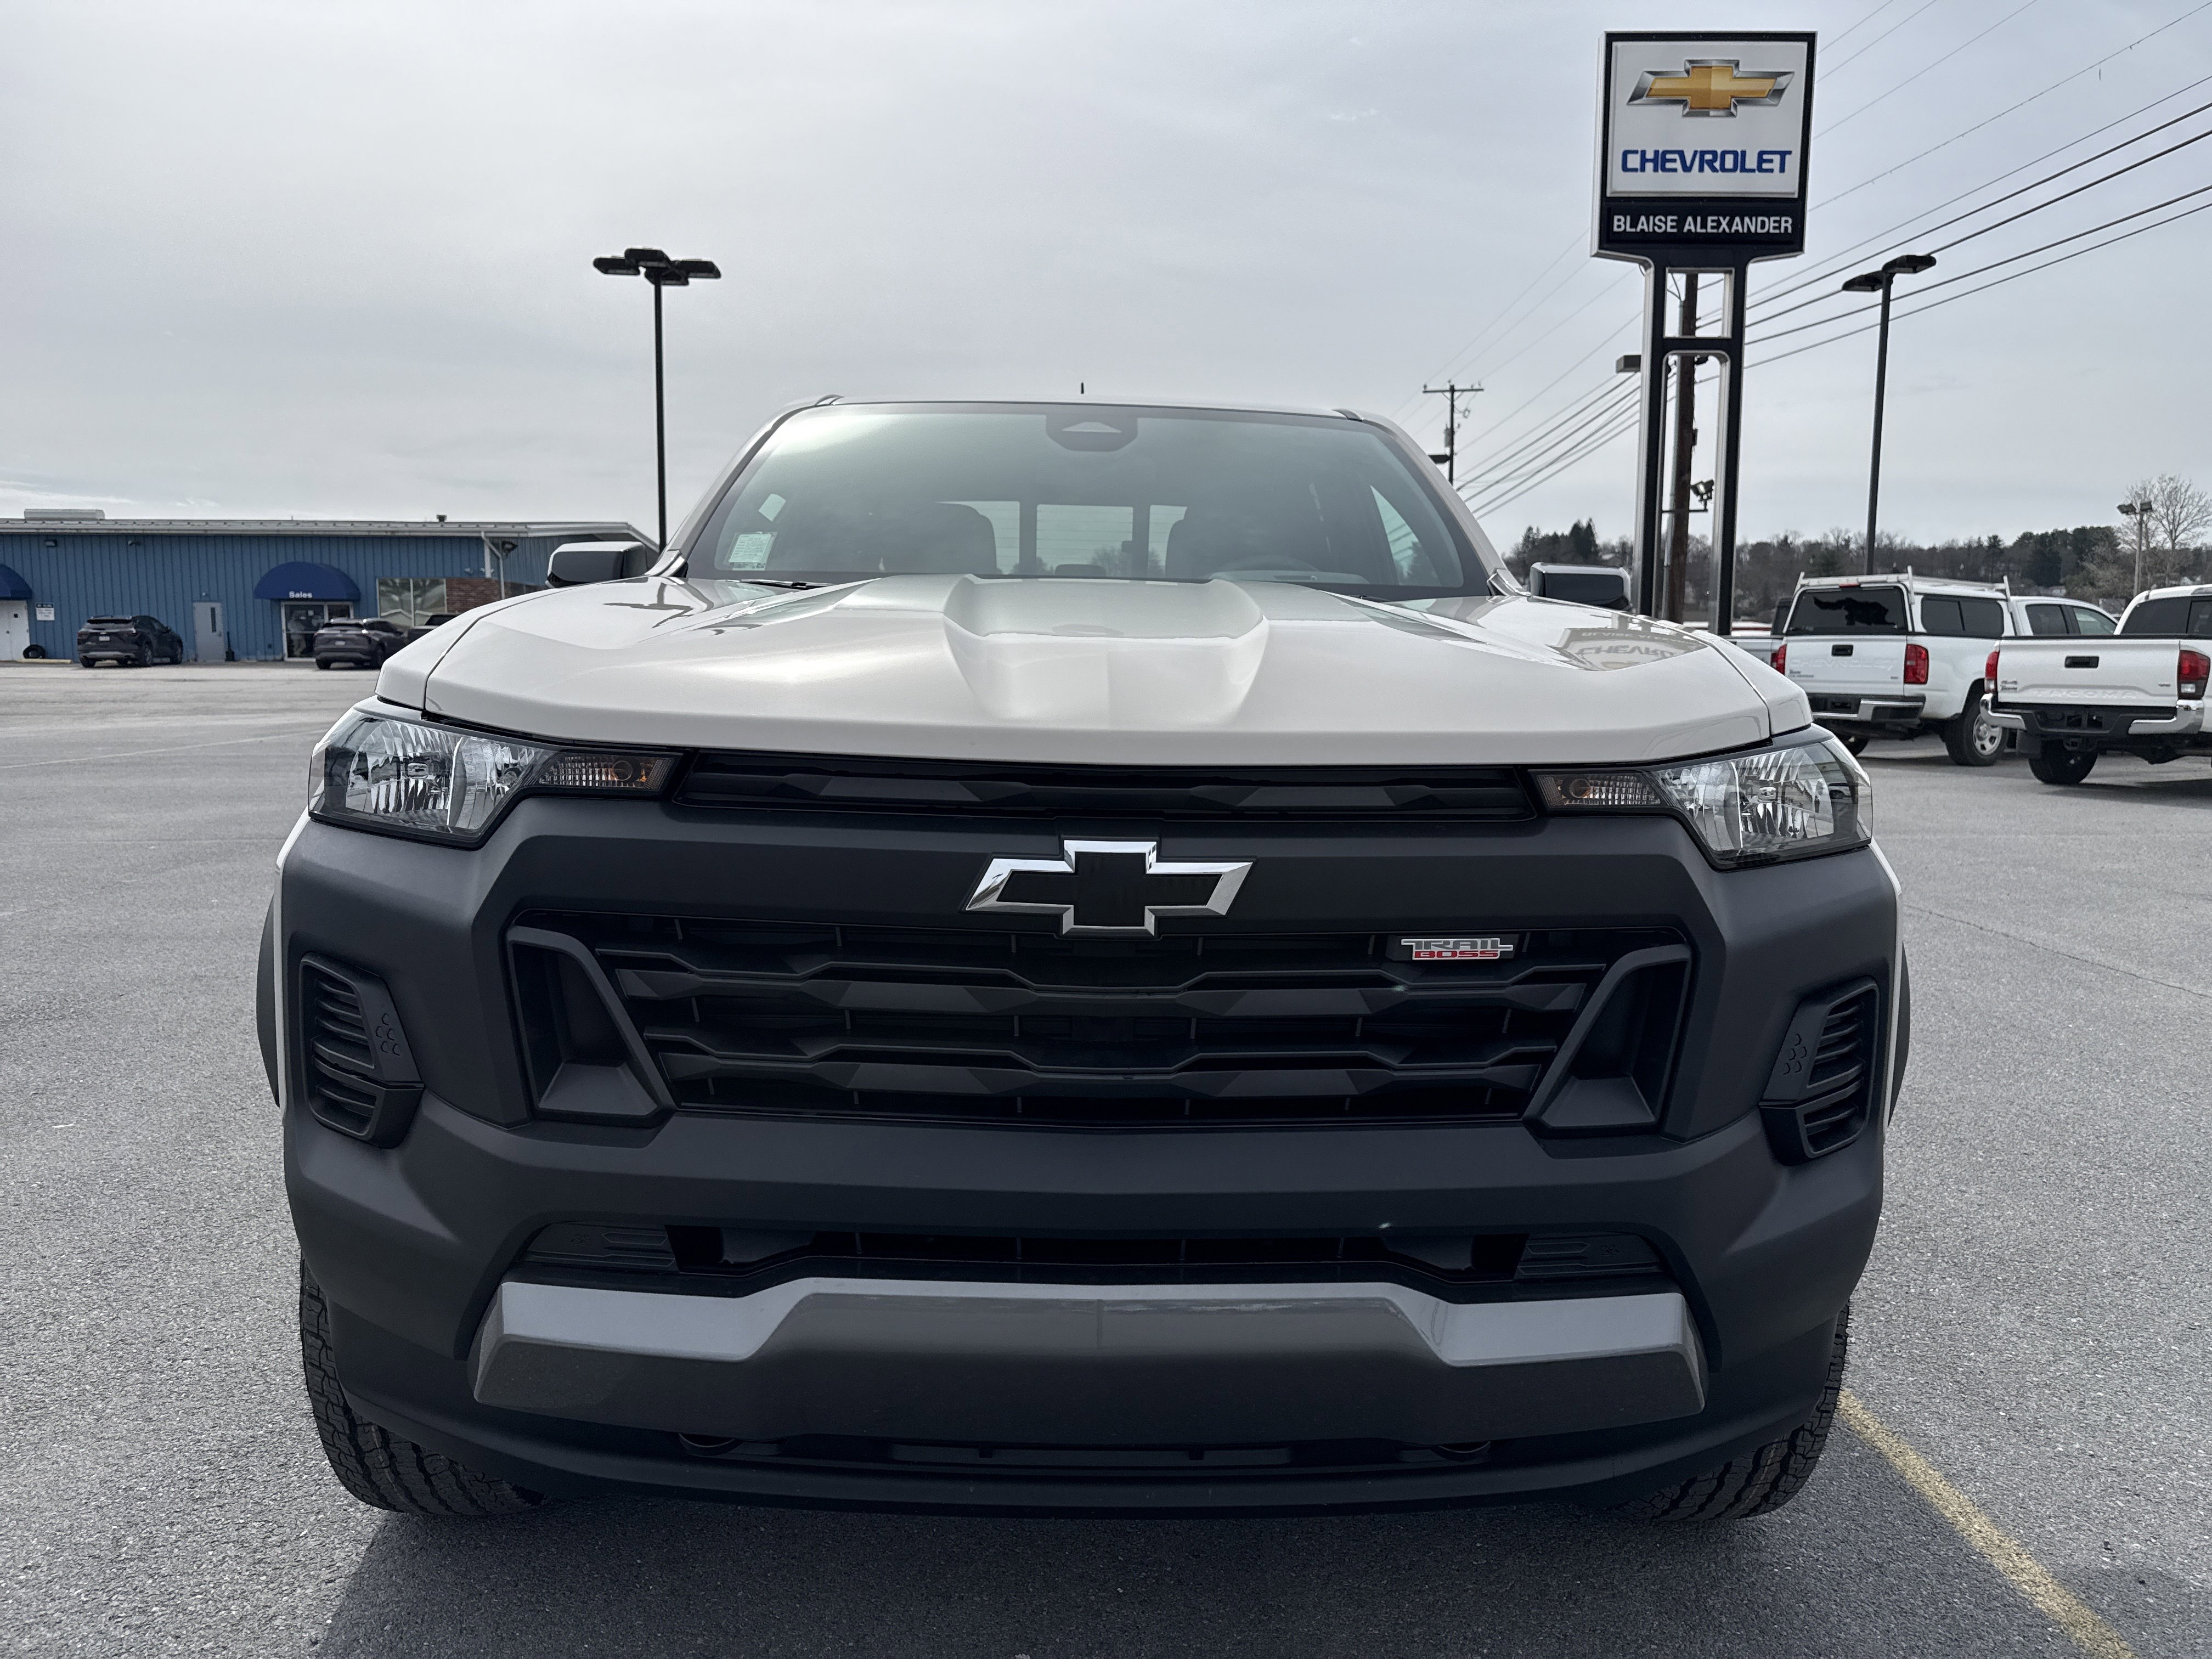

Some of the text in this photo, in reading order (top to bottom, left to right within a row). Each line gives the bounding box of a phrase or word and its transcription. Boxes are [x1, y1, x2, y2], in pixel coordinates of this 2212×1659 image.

[1621, 150, 1792, 173] CHEVROLET
[1613, 215, 1793, 234] BLAISE ALEXANDER
[2032, 690, 2137, 699] TACOMA
[1401, 938, 1513, 951] TRAIL
[1413, 950, 1500, 960] BOSS
